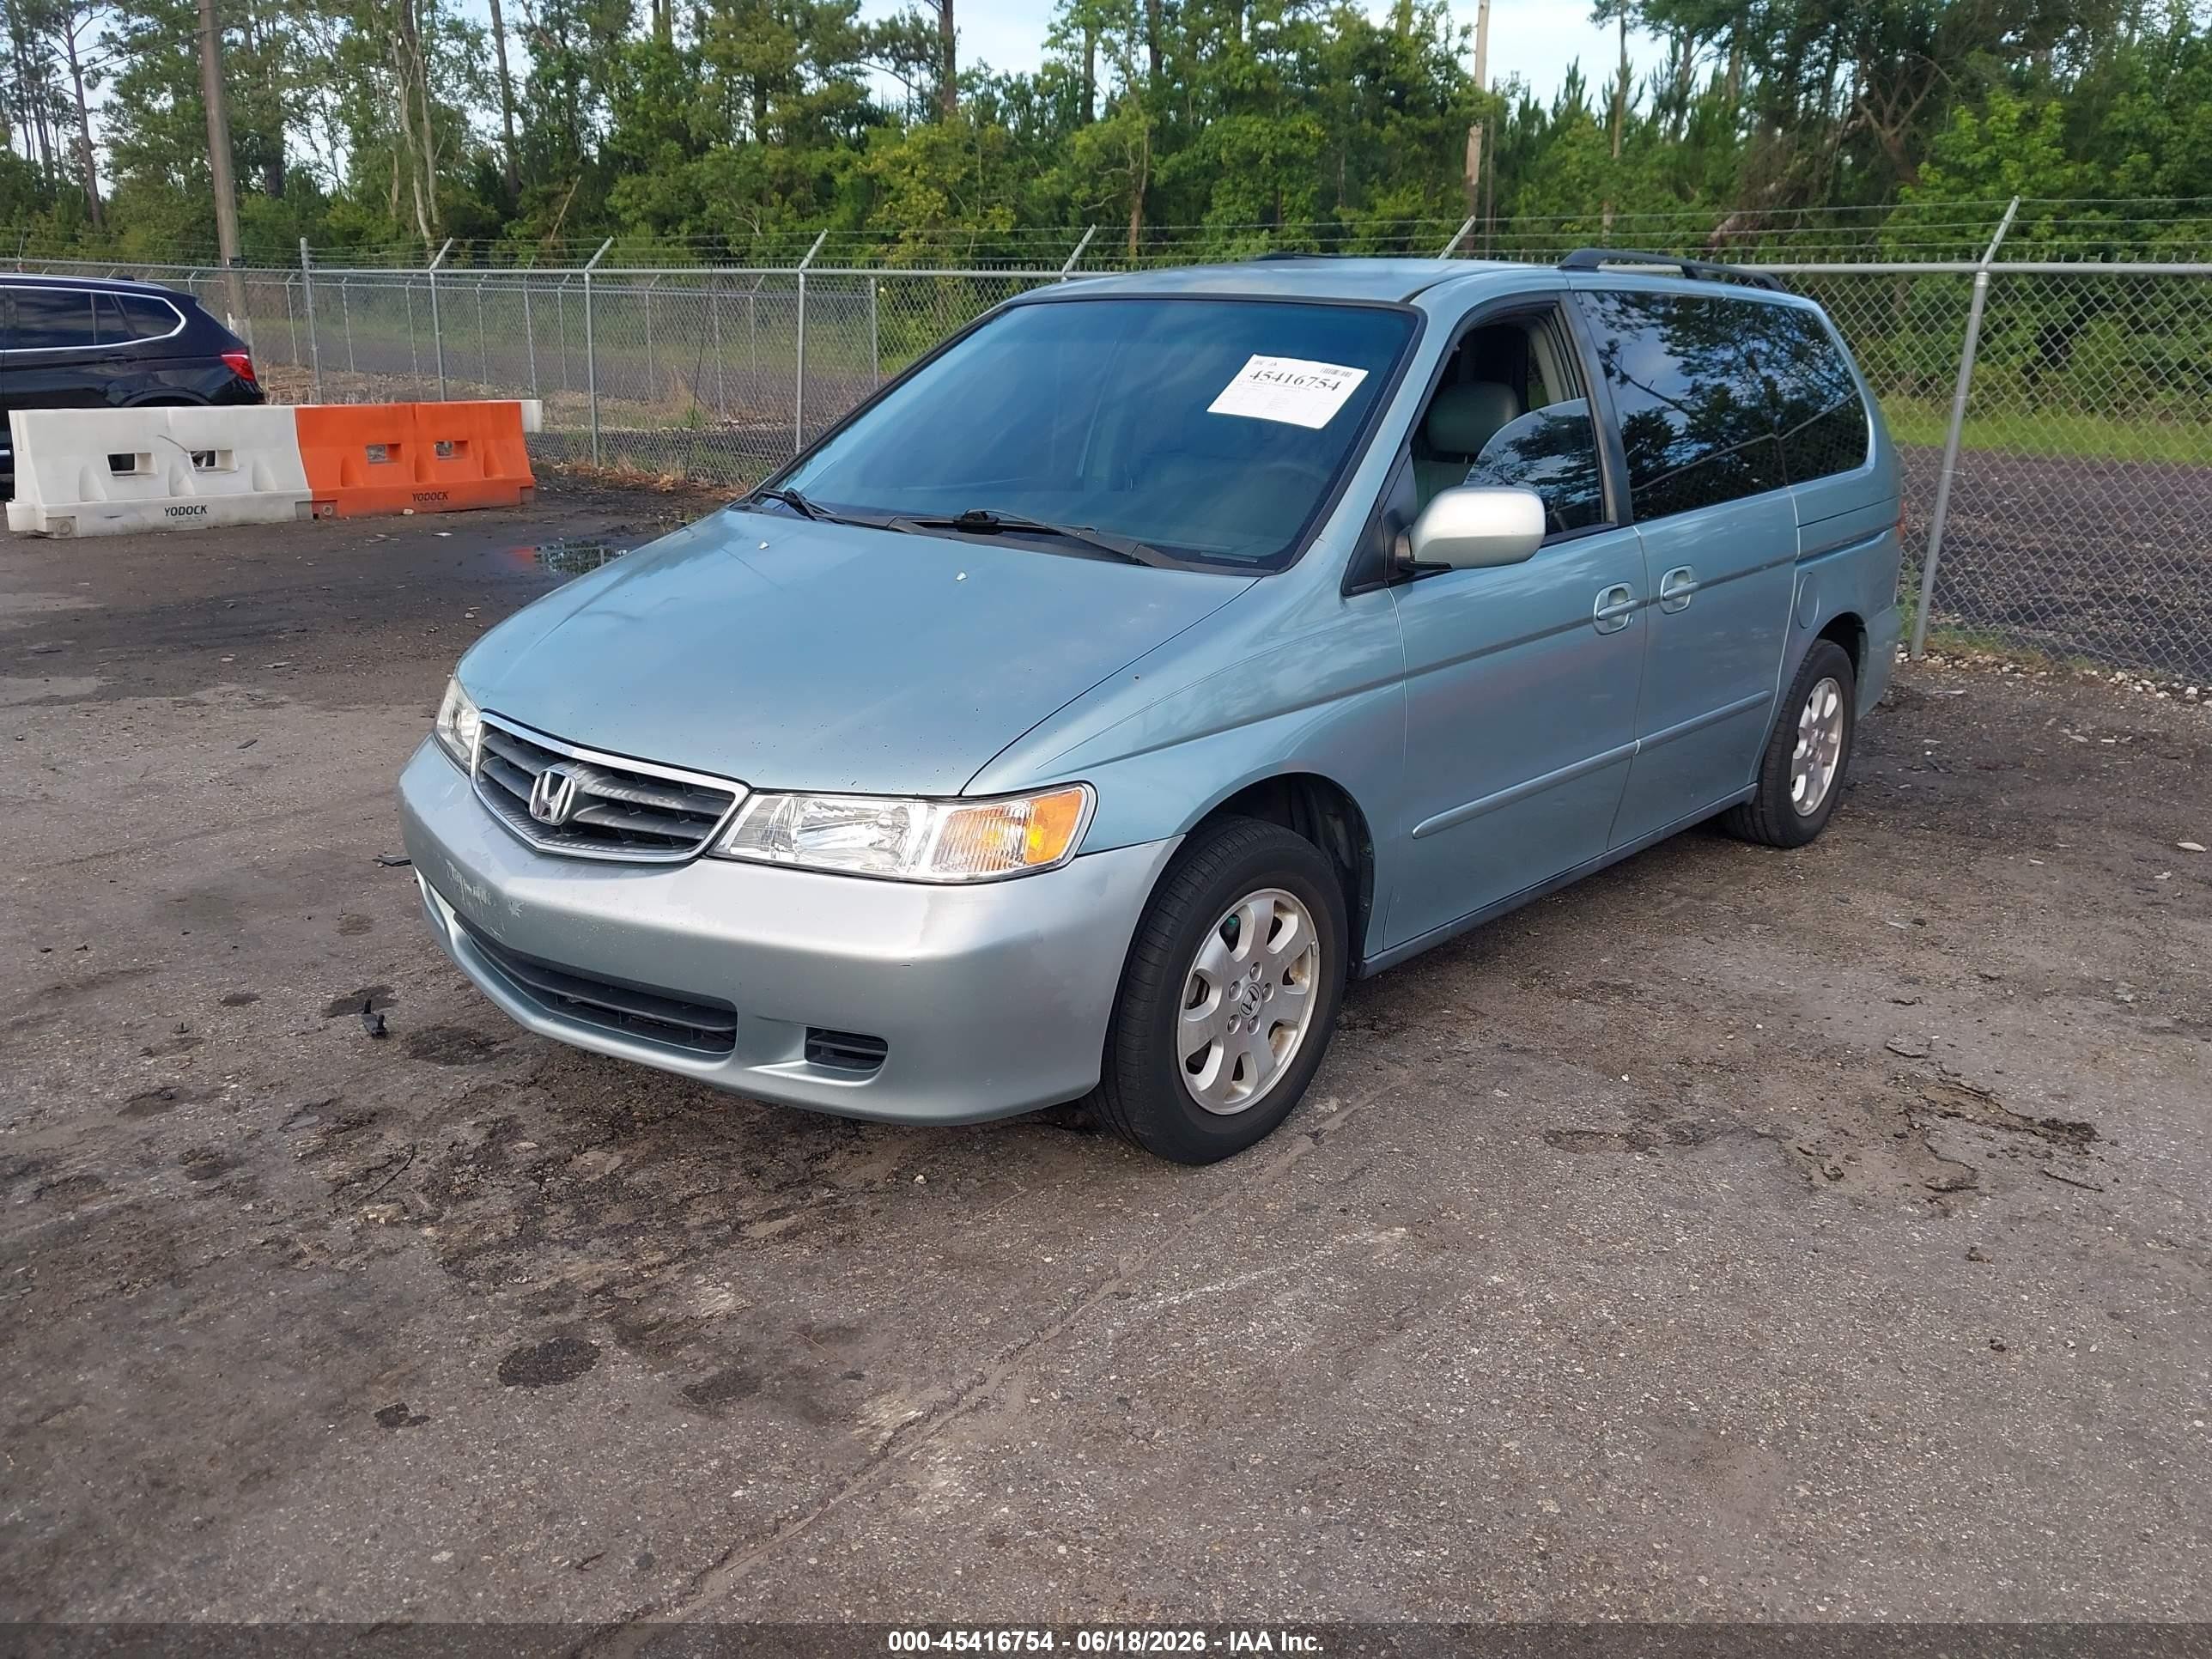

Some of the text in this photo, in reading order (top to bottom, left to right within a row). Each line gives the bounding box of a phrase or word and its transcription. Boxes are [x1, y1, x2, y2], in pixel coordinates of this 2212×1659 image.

[1249, 370, 1341, 392] 45416754
[412, 490, 449, 501] YODOCK
[164, 505, 208, 517] YODOCK
